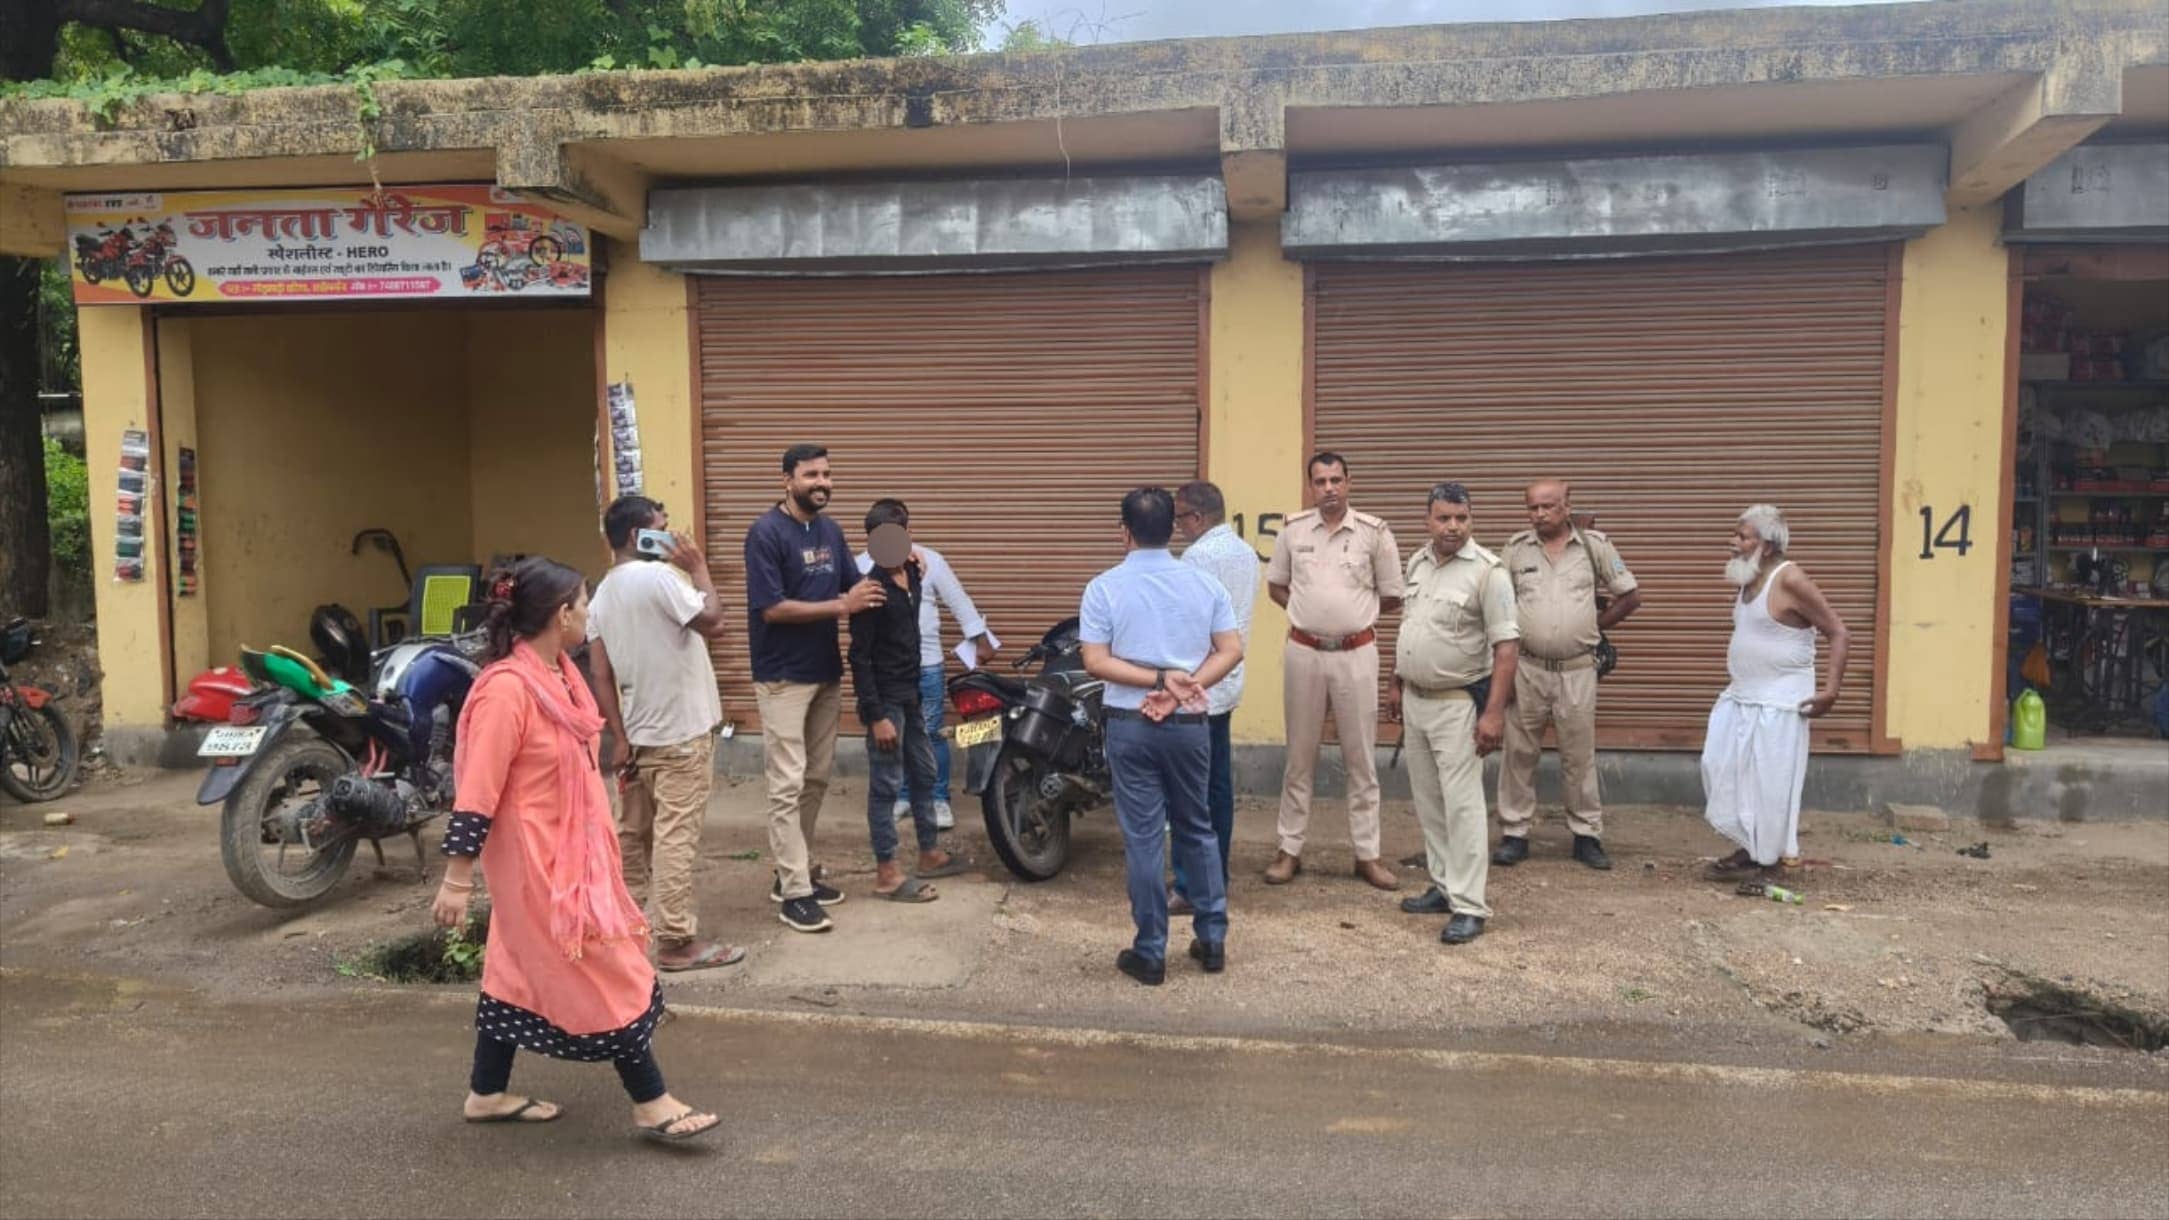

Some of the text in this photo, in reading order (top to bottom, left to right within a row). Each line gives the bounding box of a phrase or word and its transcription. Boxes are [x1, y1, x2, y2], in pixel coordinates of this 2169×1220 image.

[184, 208, 342, 242] जनता
[346, 246, 389, 258] HERO
[1232, 512, 1284, 564] 15
[1919, 504, 1973, 560] 14
